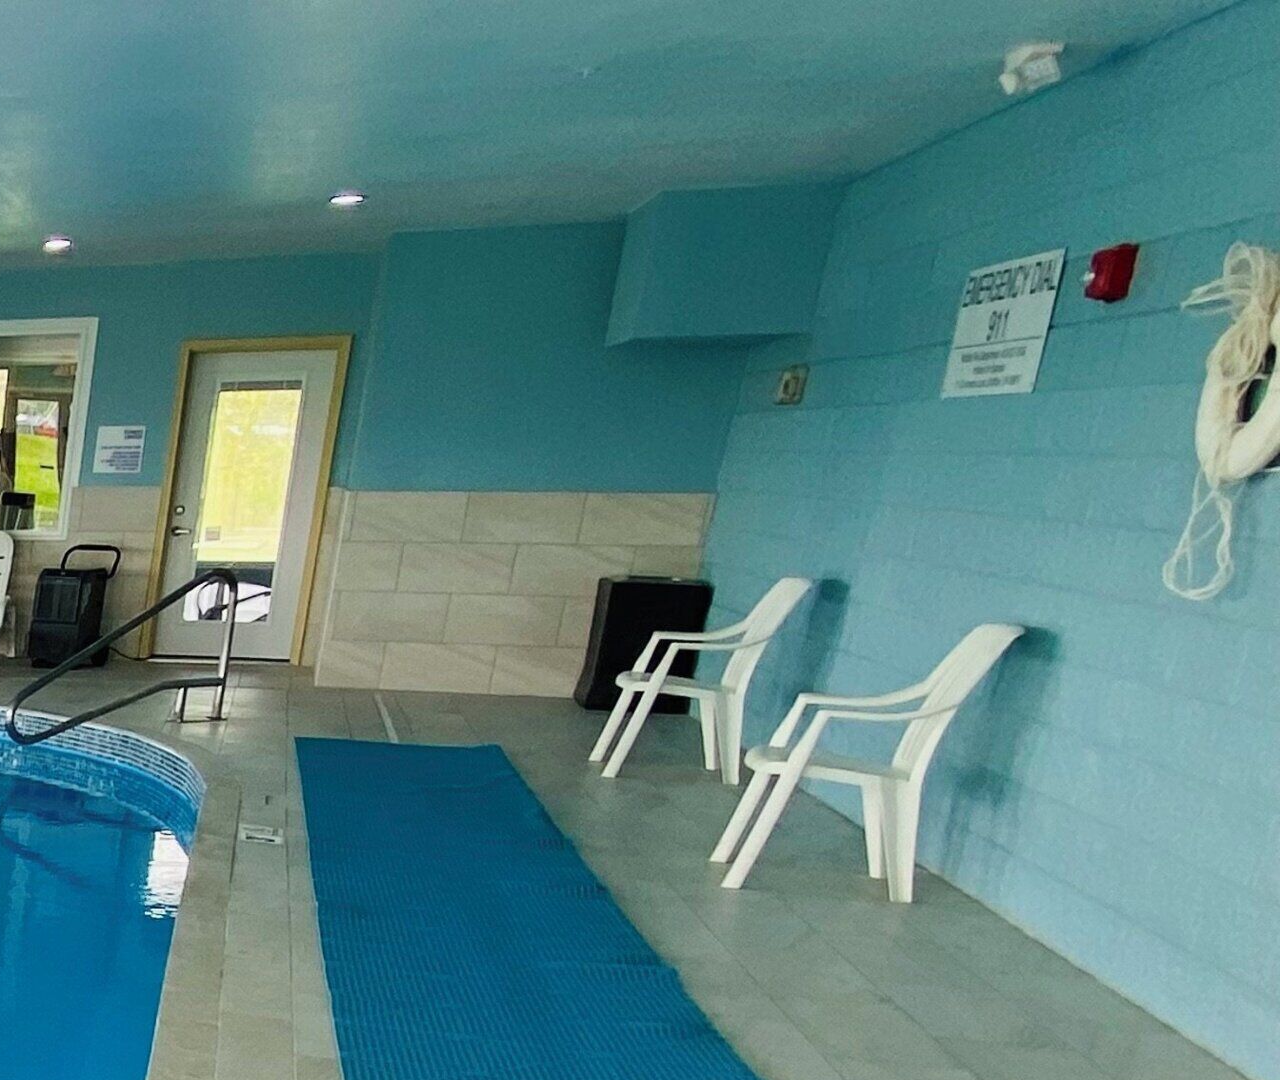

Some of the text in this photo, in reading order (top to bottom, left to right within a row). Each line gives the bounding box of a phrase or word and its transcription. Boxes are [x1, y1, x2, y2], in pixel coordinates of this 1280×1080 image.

[962, 258, 1057, 308] EMERGENCY DIAL
[986, 309, 1010, 341] 911
